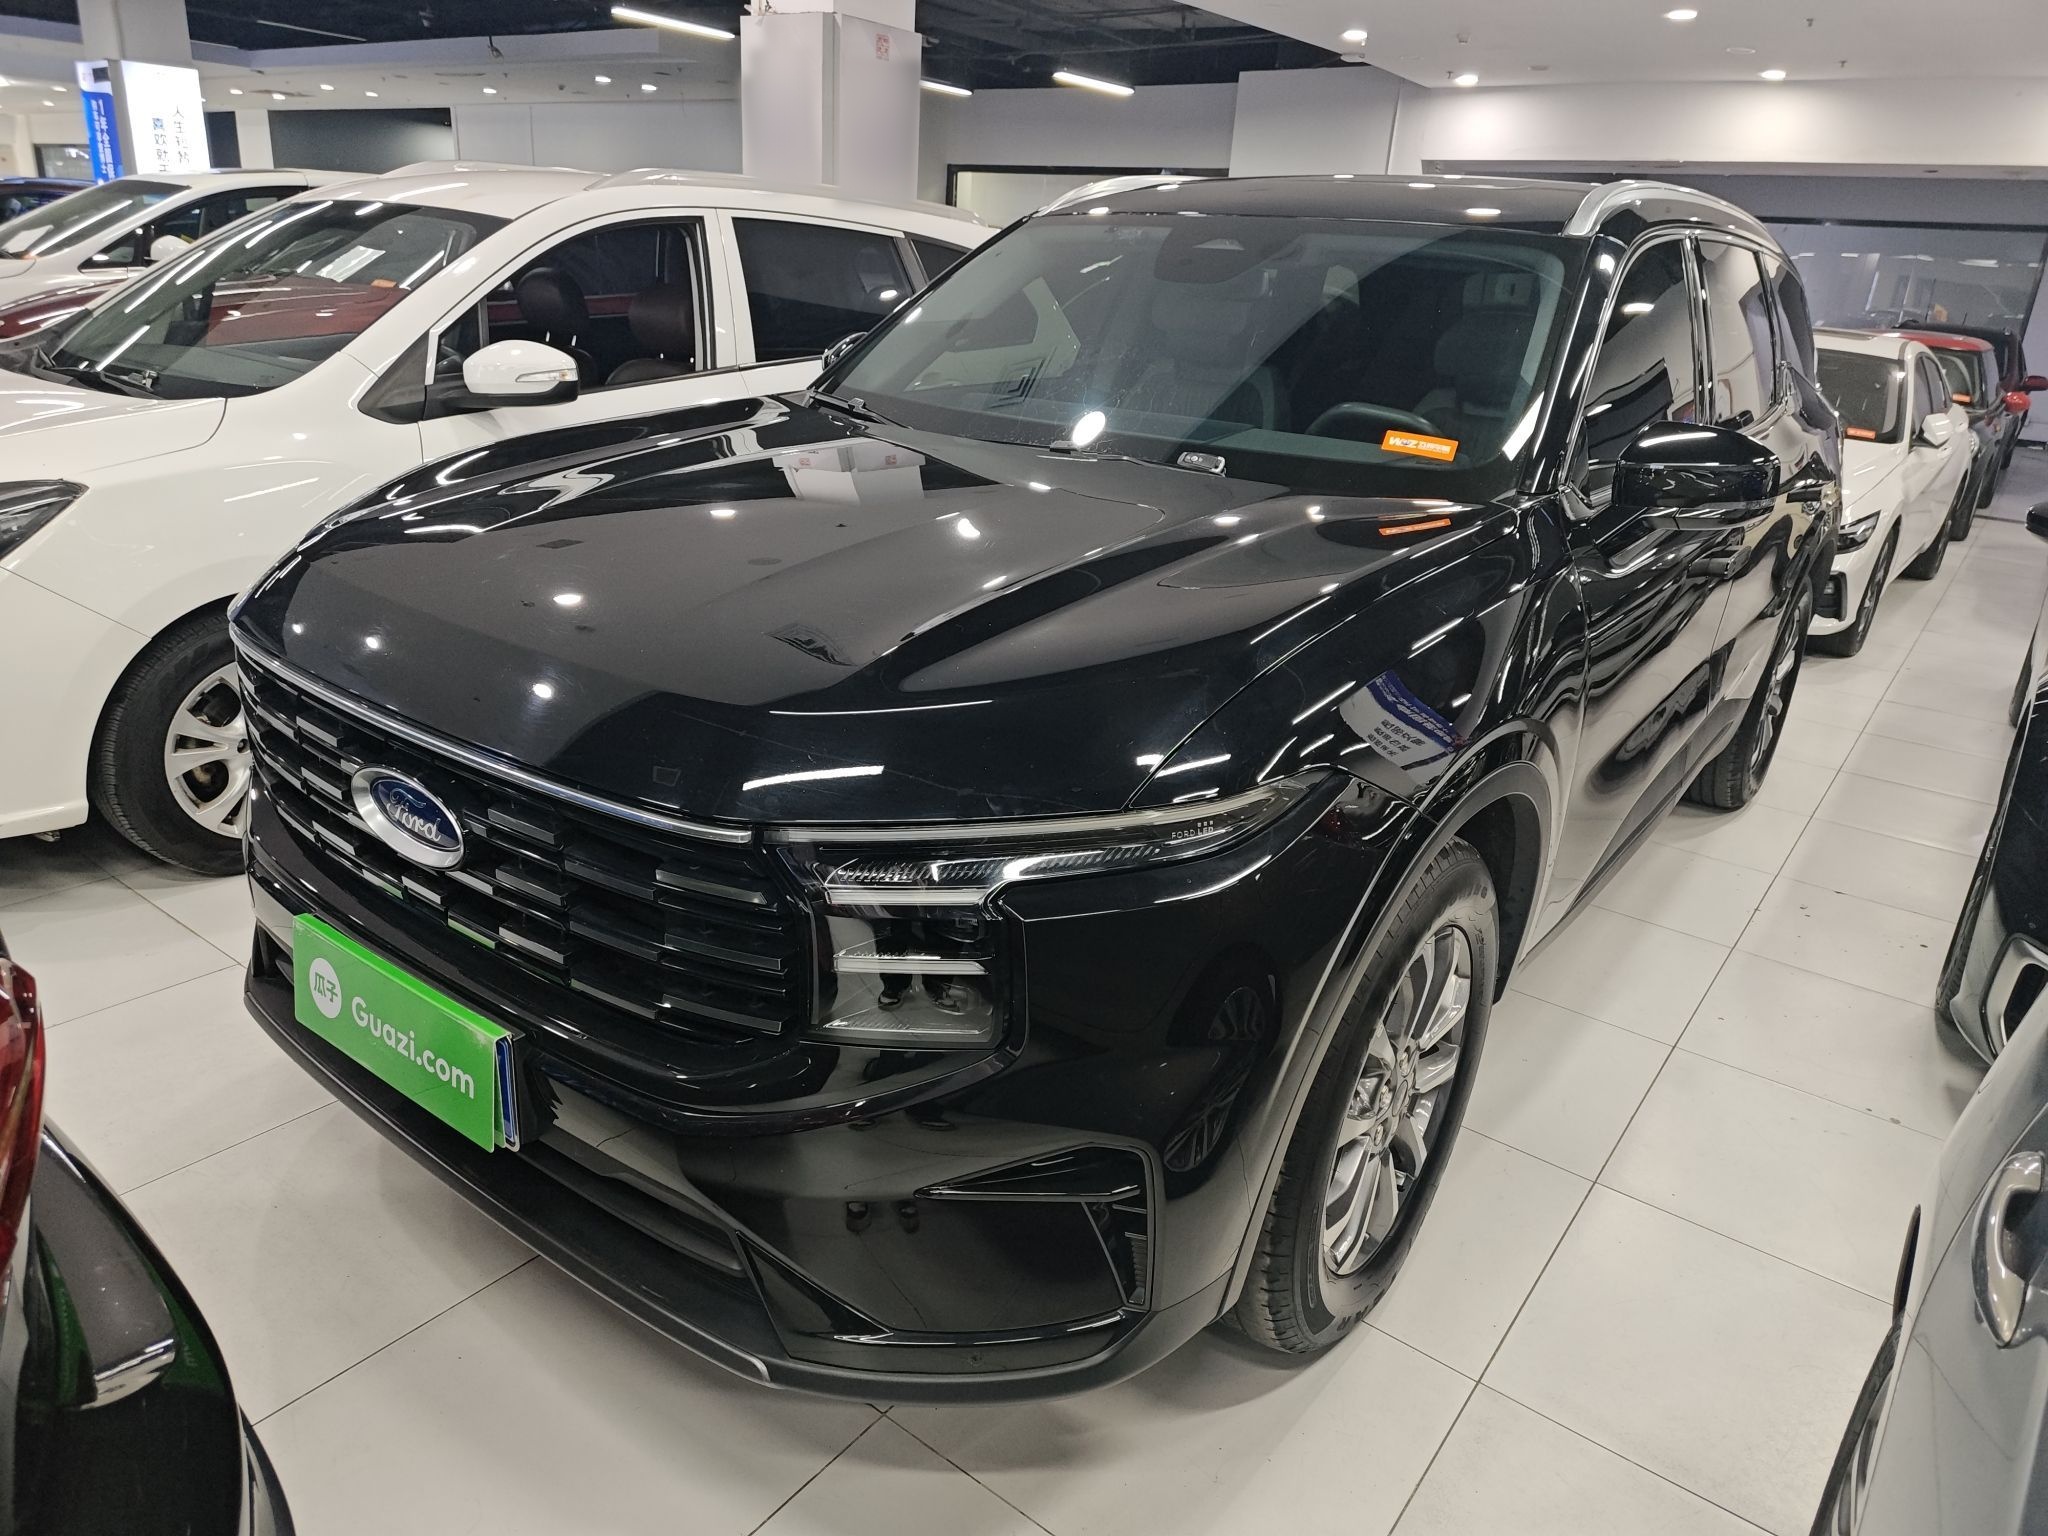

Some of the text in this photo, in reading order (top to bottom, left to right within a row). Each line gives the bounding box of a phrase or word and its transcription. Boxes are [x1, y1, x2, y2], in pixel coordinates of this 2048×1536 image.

[387, 788, 441, 841] Ford
[1171, 826, 1214, 840] FORD LED
[313, 971, 338, 1004] 瓜子
[351, 996, 475, 1100] Guazi.com
